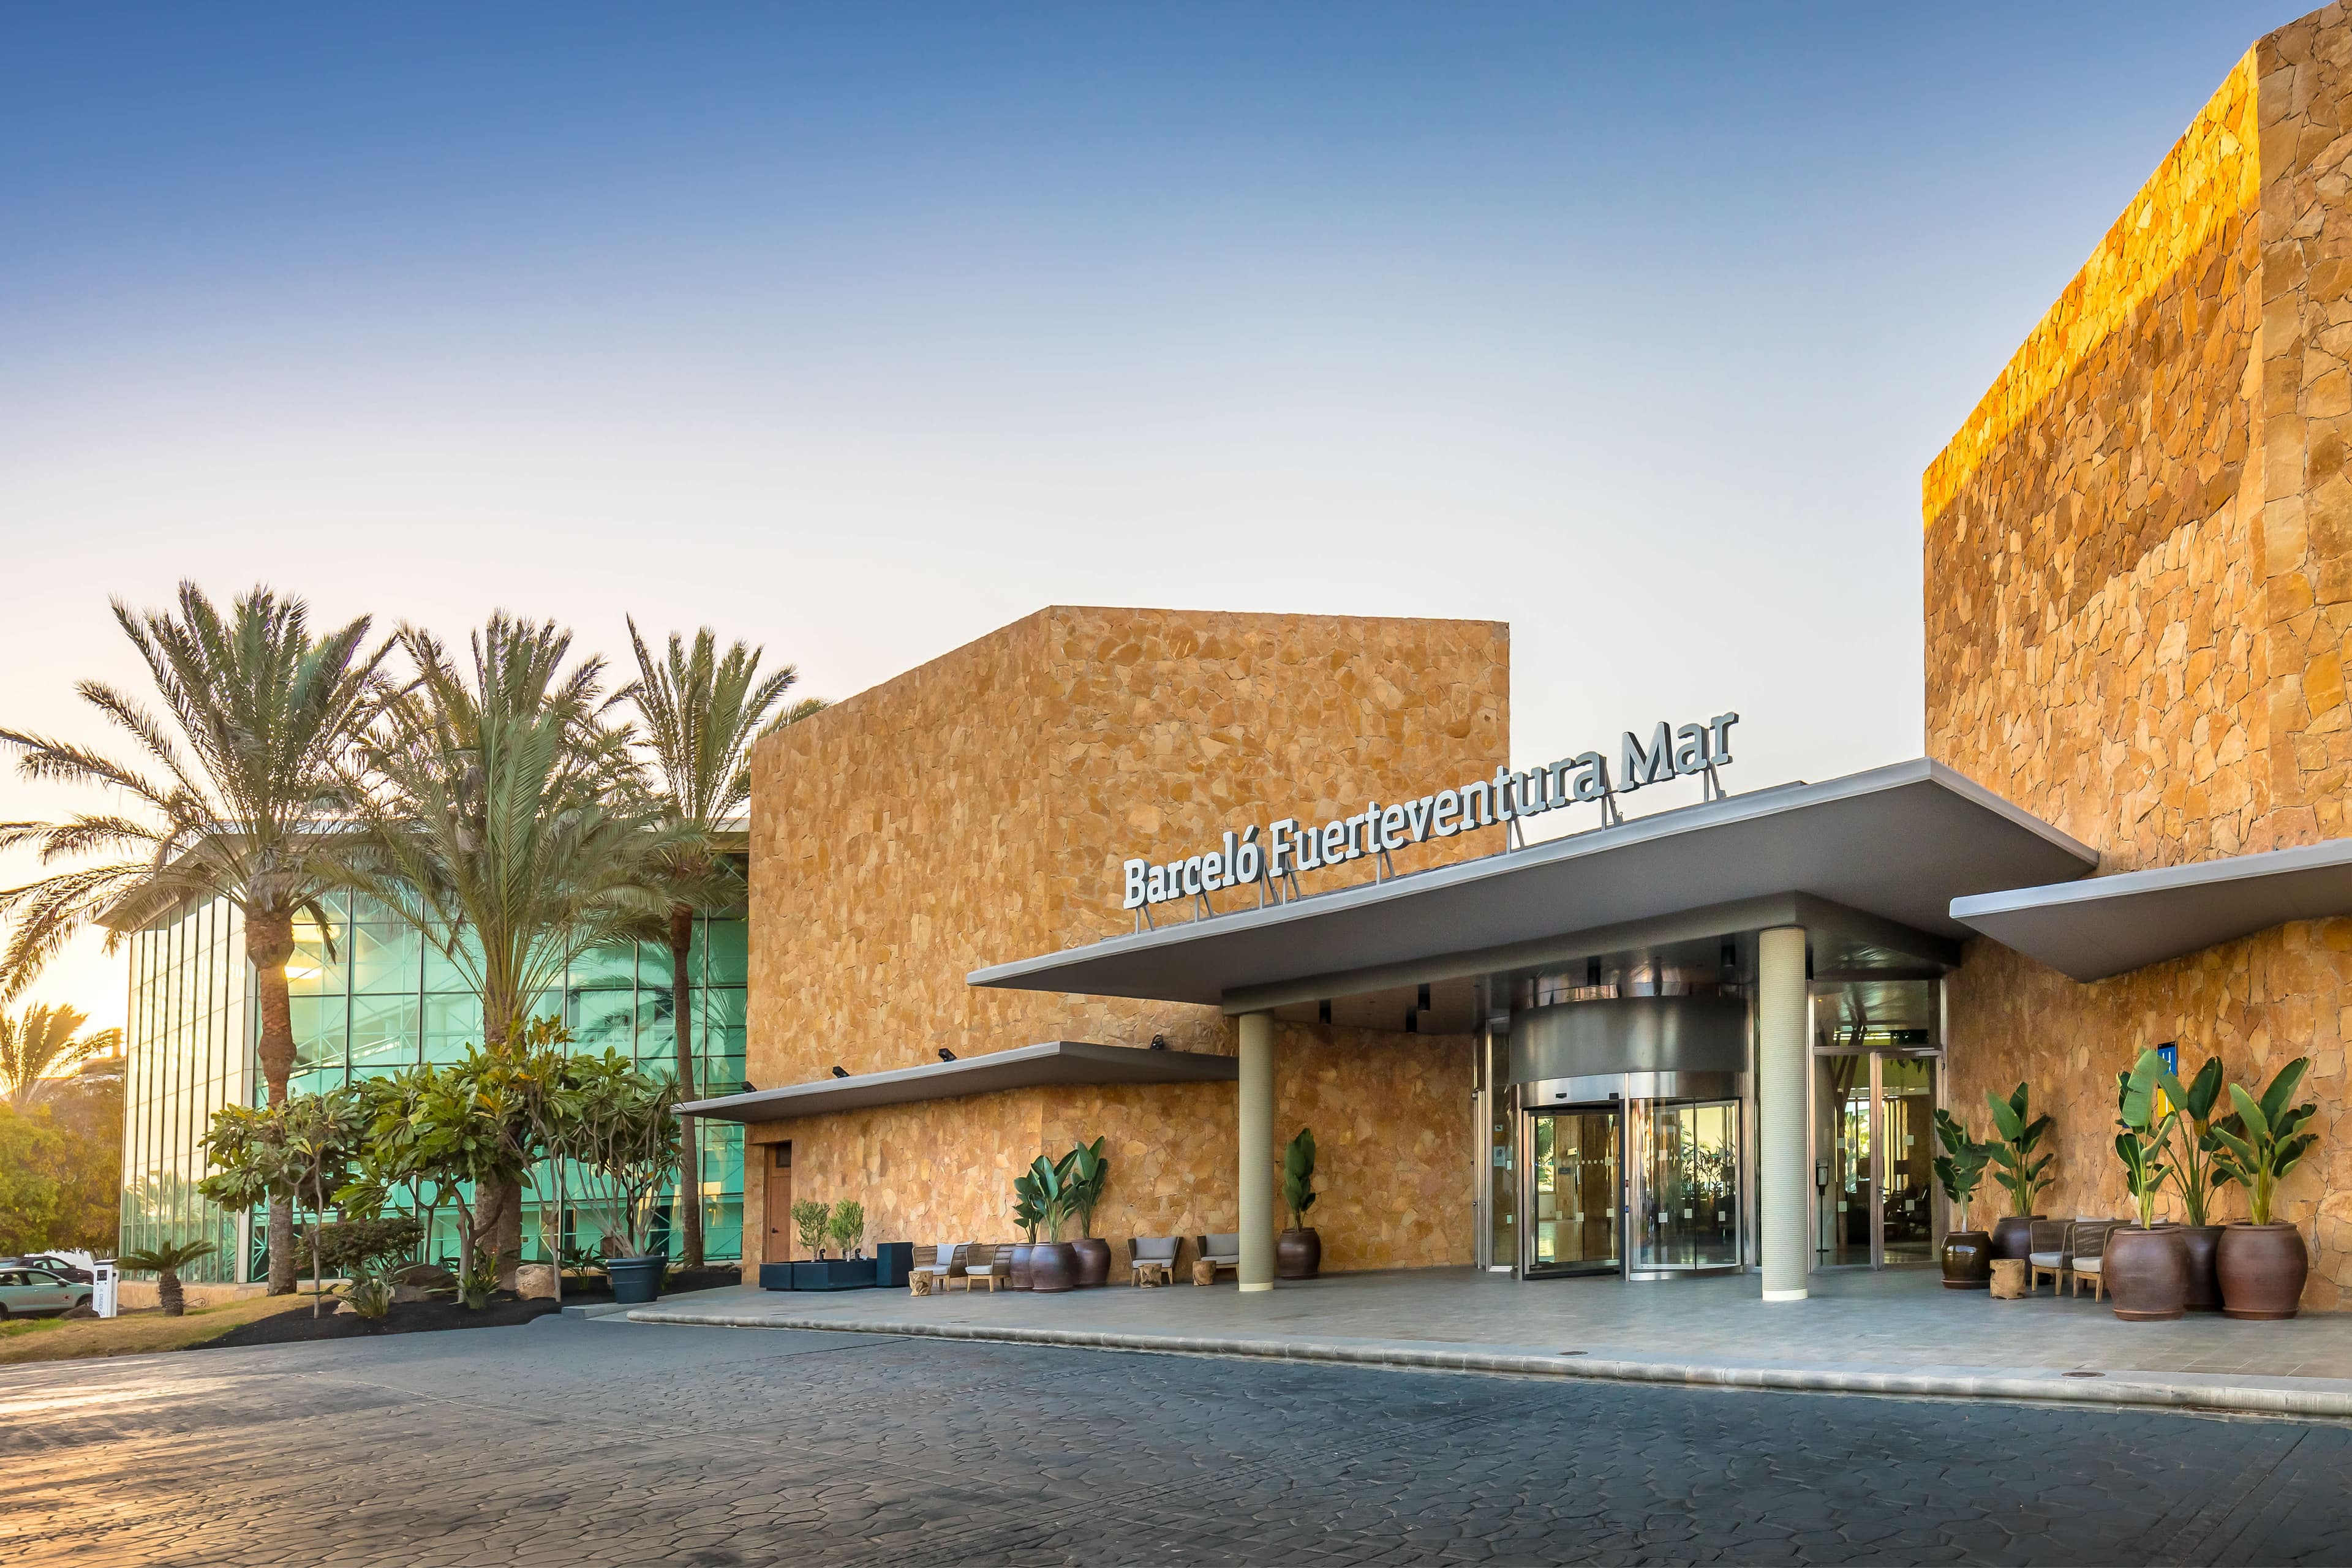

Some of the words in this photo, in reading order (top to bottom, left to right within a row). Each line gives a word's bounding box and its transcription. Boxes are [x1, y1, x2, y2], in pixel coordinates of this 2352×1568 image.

[1123, 824, 1265, 910] Barceló
[1269, 750, 1606, 878] Fuerteventura
[1618, 711, 1739, 792] Mar
